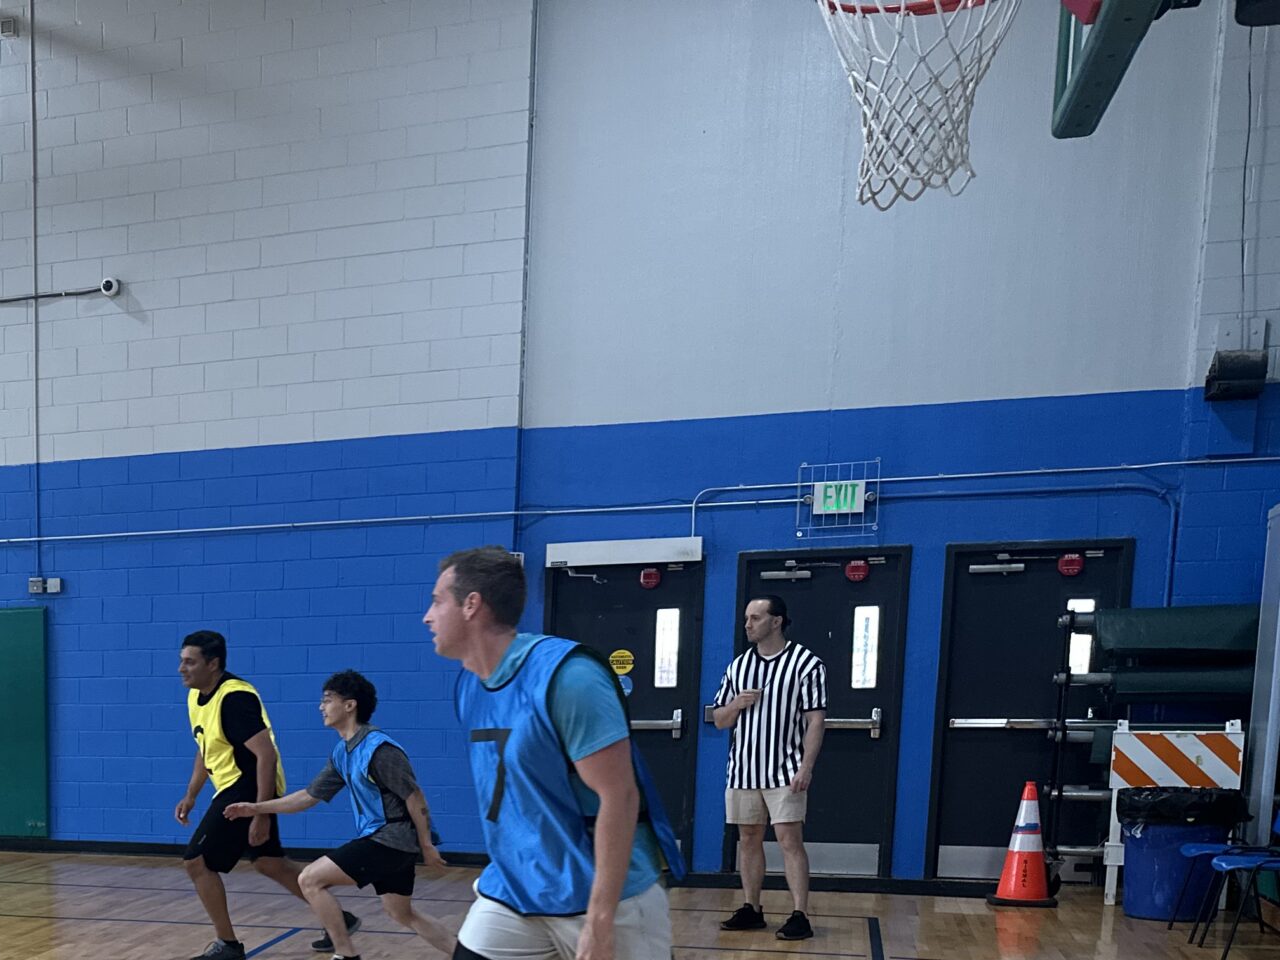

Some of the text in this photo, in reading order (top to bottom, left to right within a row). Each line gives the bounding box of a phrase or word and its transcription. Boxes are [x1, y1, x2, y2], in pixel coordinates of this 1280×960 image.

[823, 483, 859, 511] EXIT
[470, 728, 513, 824] 7
[1021, 859, 1029, 888] SIGNAL
